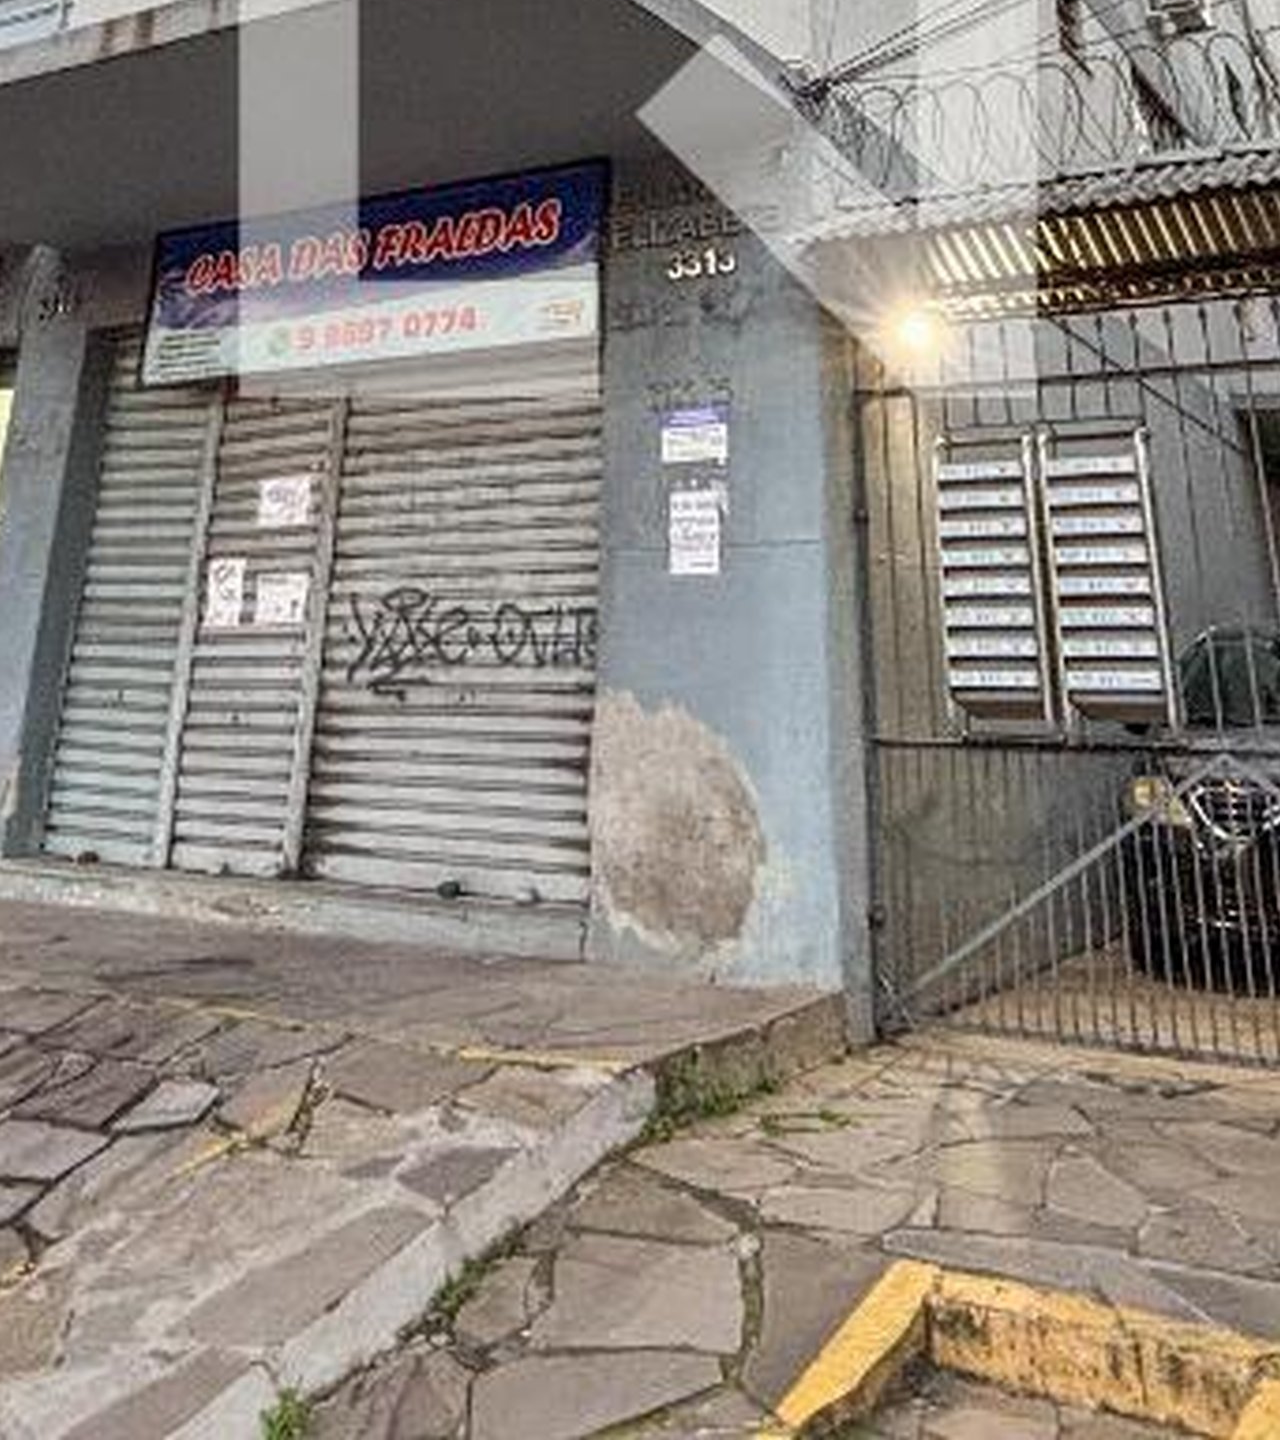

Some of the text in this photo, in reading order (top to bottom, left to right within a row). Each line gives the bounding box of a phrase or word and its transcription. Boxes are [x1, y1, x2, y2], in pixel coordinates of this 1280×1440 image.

[185, 199, 562, 297] CASA DAS FRALDAS
